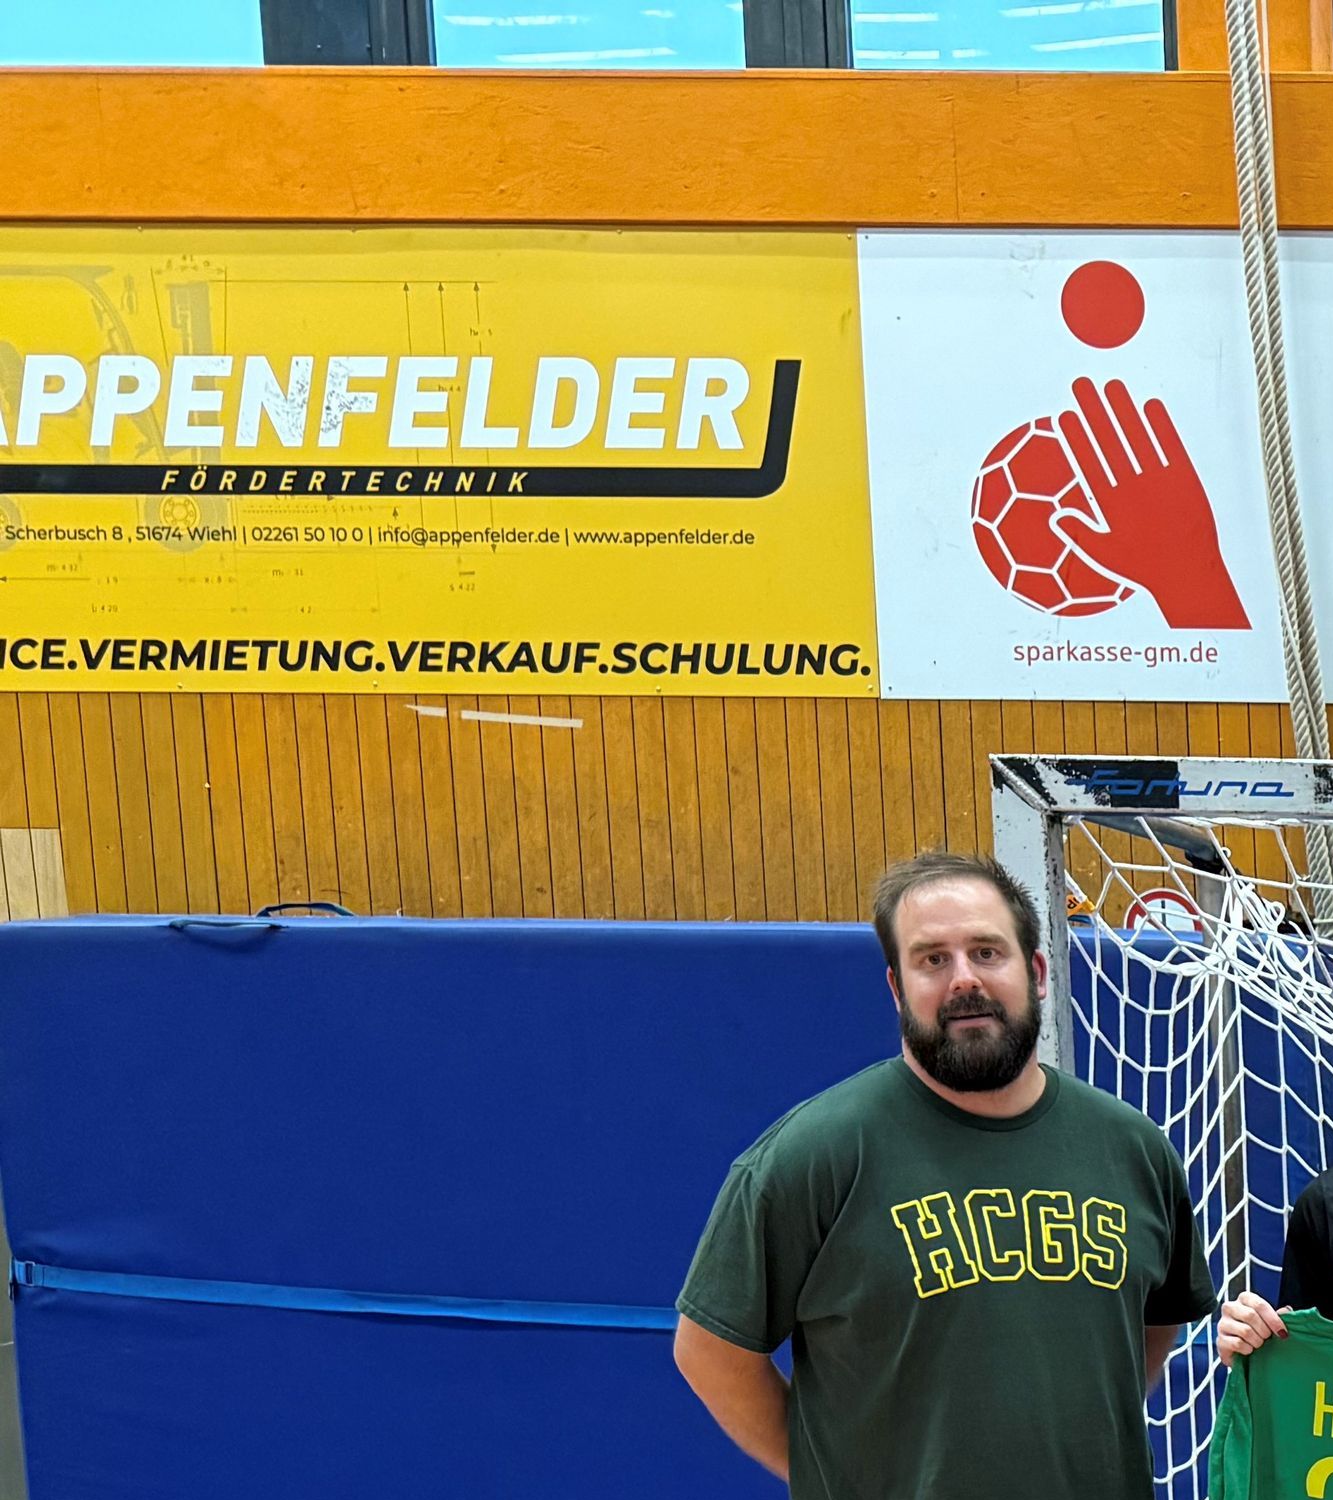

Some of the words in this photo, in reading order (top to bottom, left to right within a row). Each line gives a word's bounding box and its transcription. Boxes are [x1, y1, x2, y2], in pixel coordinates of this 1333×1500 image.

[0, 354, 751, 451] PPENFELDER
[160, 464, 529, 493] FÖRDERTECHNIK
[5, 525, 108, 542] Scherbusch
[112, 527, 123, 542] 8
[135, 526, 183, 542] 51674
[187, 525, 237, 542] Wiehl
[252, 526, 300, 543] 02261
[304, 526, 326, 543] 50
[329, 526, 348, 543] 10
[352, 527, 364, 543] 0
[377, 526, 561, 548] info@appenfelder.de
[573, 527, 755, 548] www.appenfelder.de
[1013, 640, 1218, 668] sparkasse-gm.de
[890, 1187, 1128, 1299] HCGS
